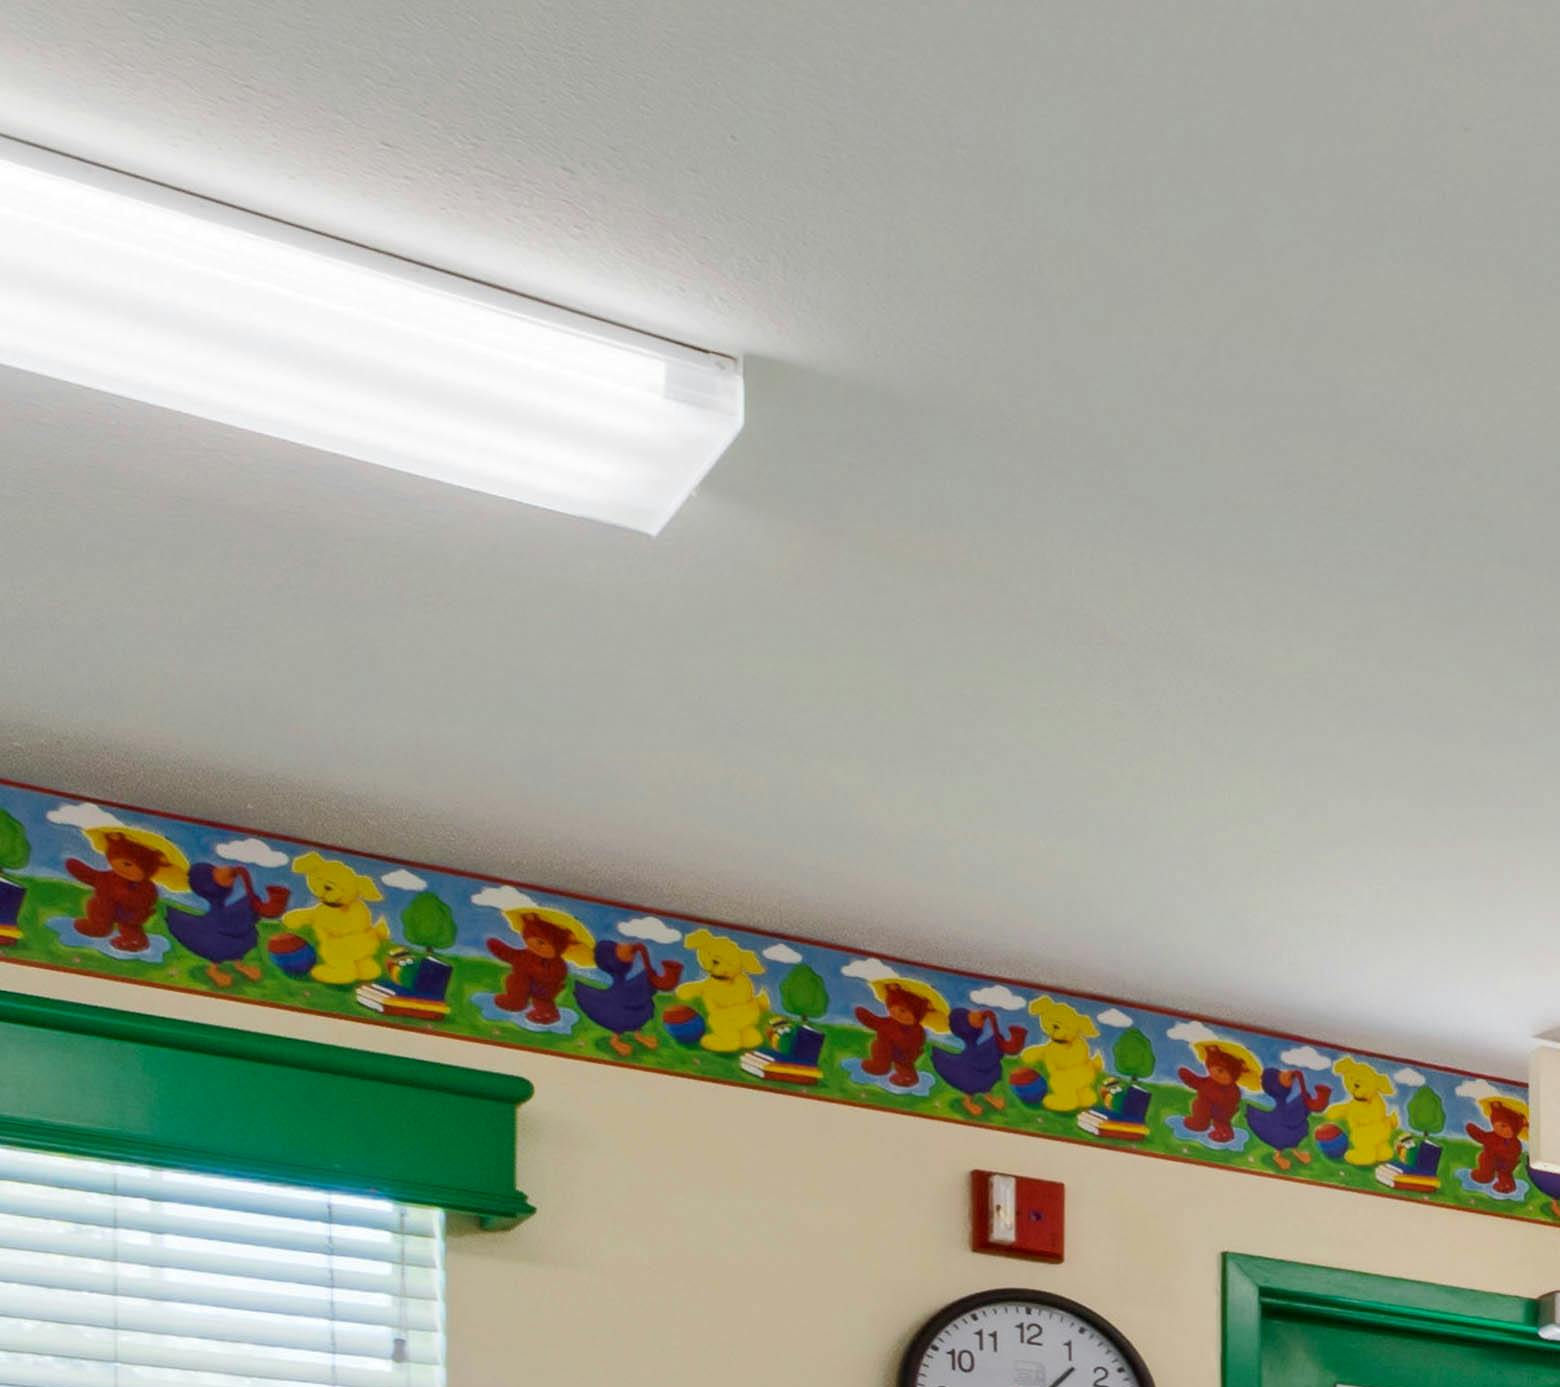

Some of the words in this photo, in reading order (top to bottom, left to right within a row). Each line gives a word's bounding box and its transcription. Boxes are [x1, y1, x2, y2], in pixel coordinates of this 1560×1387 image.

[973, 1329, 999, 1352] 11
[1014, 1322, 1043, 1346] 12
[946, 1349, 975, 1373] 10
[1063, 1340, 1074, 1361] 1
